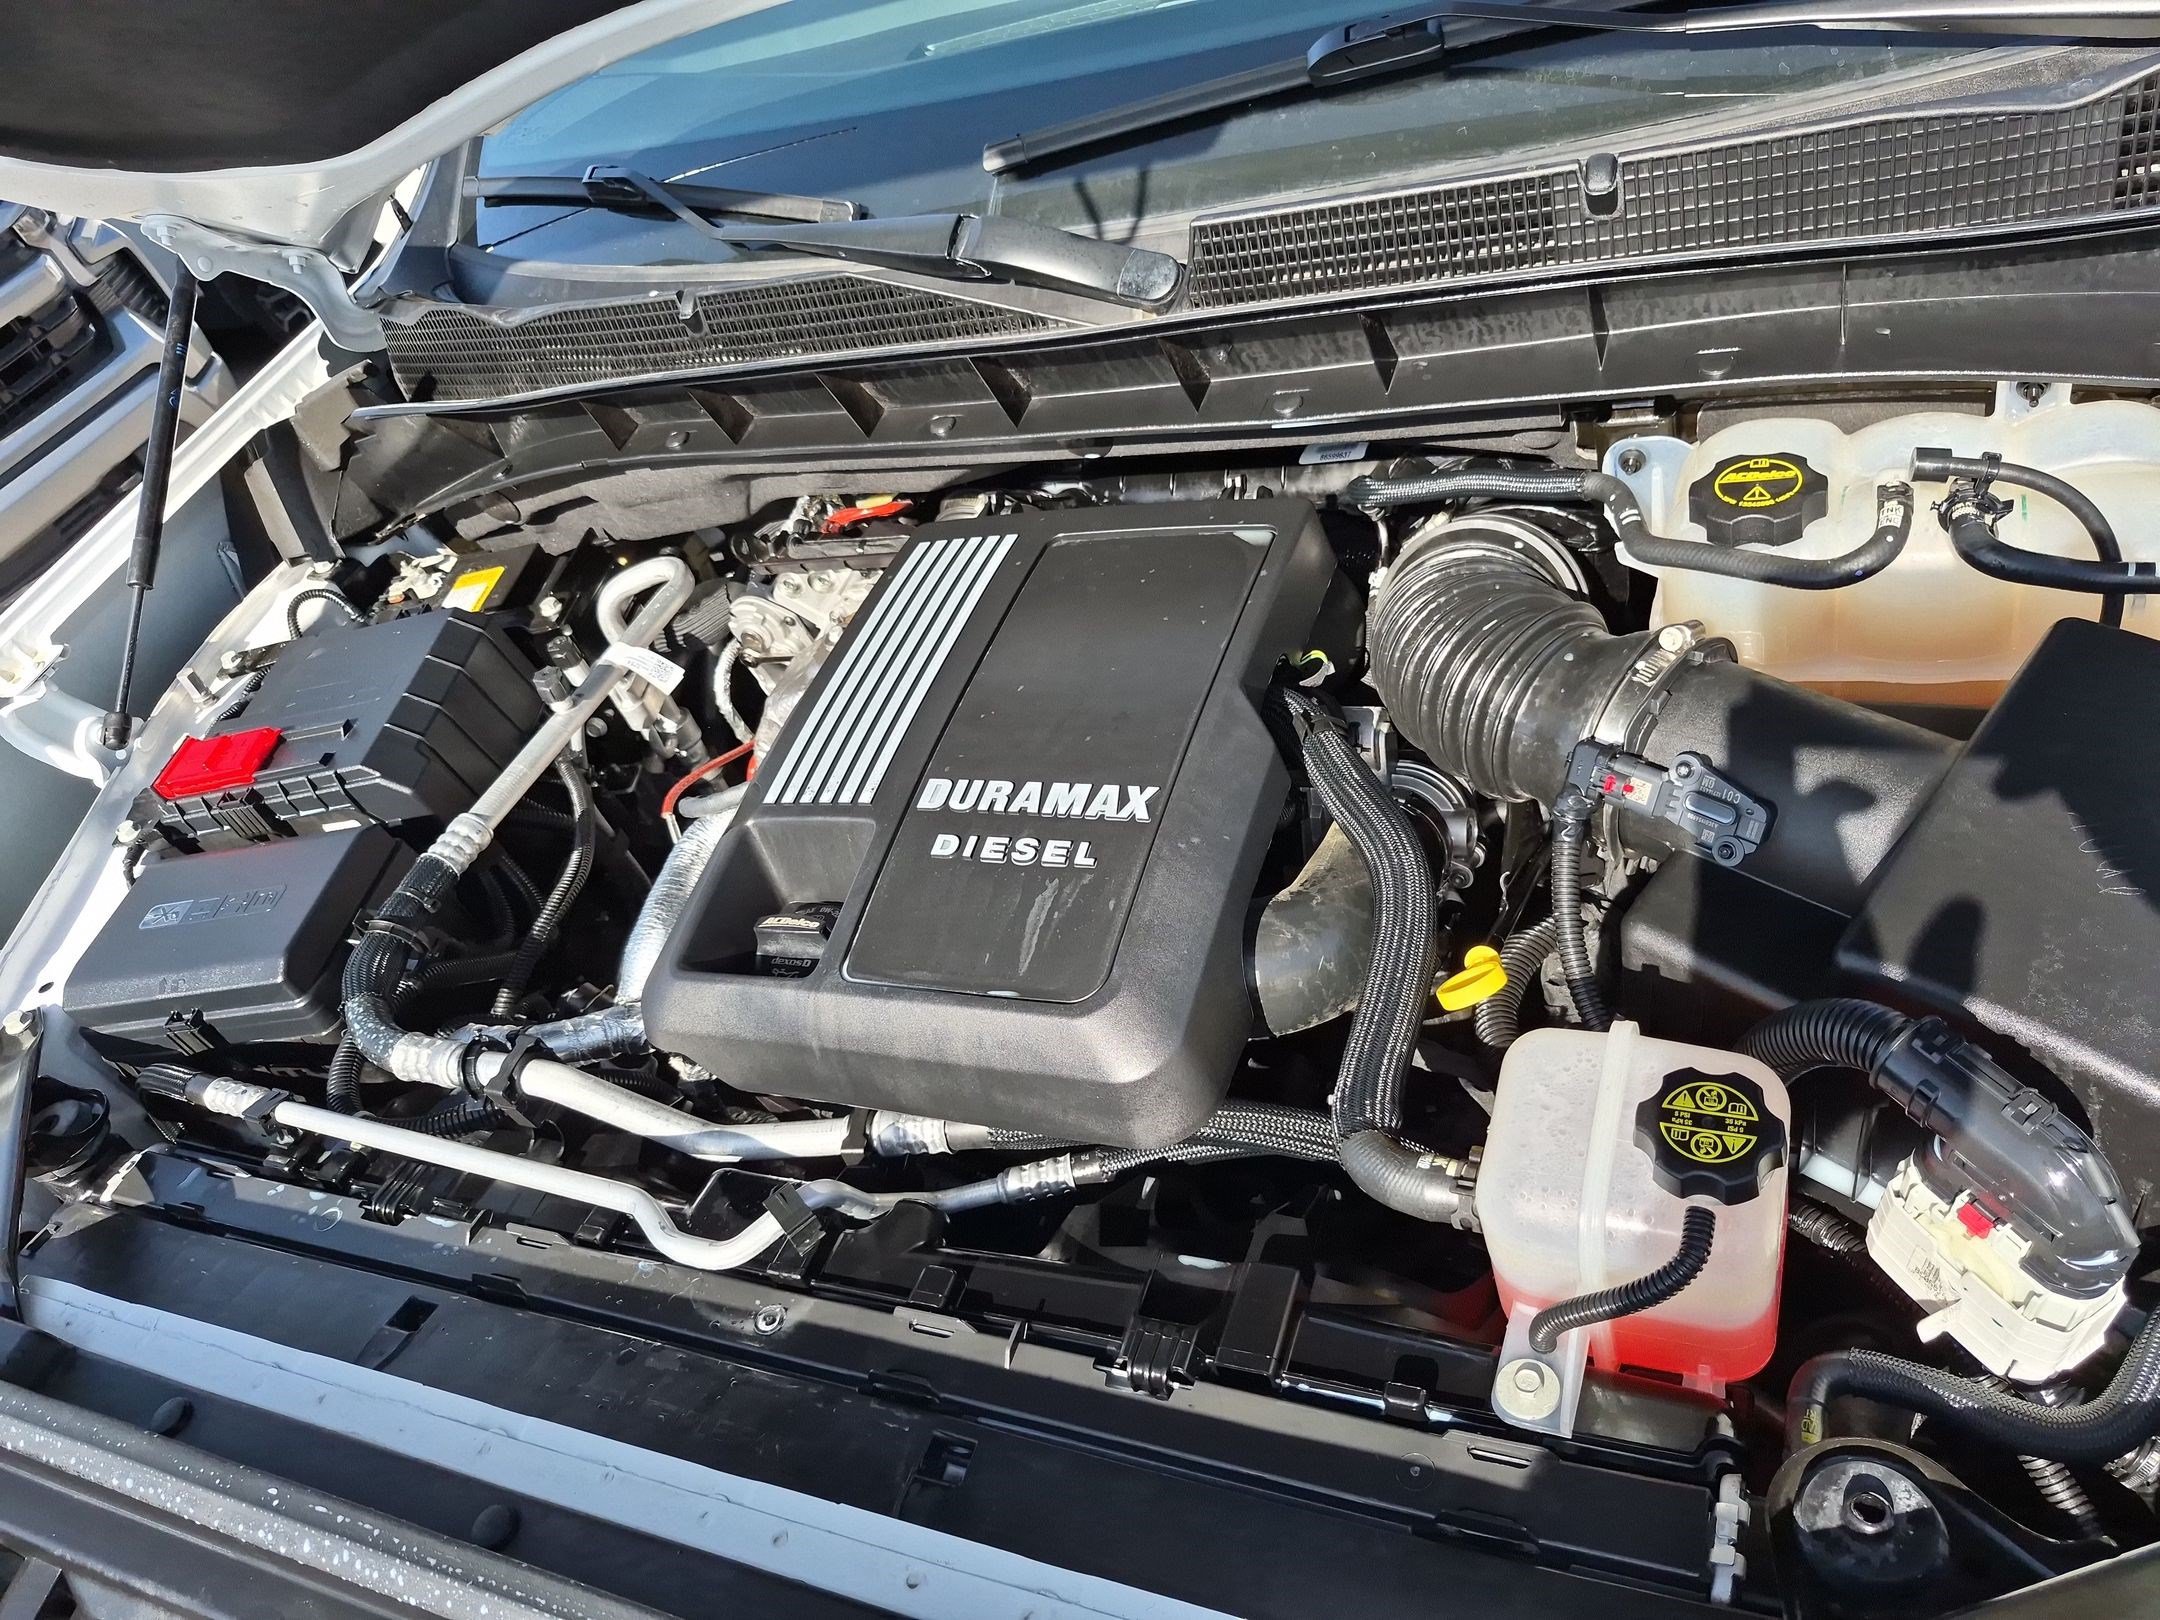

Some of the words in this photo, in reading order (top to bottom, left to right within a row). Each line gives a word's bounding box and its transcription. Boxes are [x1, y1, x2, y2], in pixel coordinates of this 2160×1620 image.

[1719, 470, 1797, 484] ACDelco
[1701, 776, 1716, 789] GM
[917, 778, 1160, 823] DURAMAX
[1722, 789, 1741, 804] C01
[930, 833, 1098, 868] DIESEL
[758, 916, 820, 928] ACDelco
[1680, 1111, 1691, 1119] PSI
[1734, 1119, 1747, 1127] kPa
